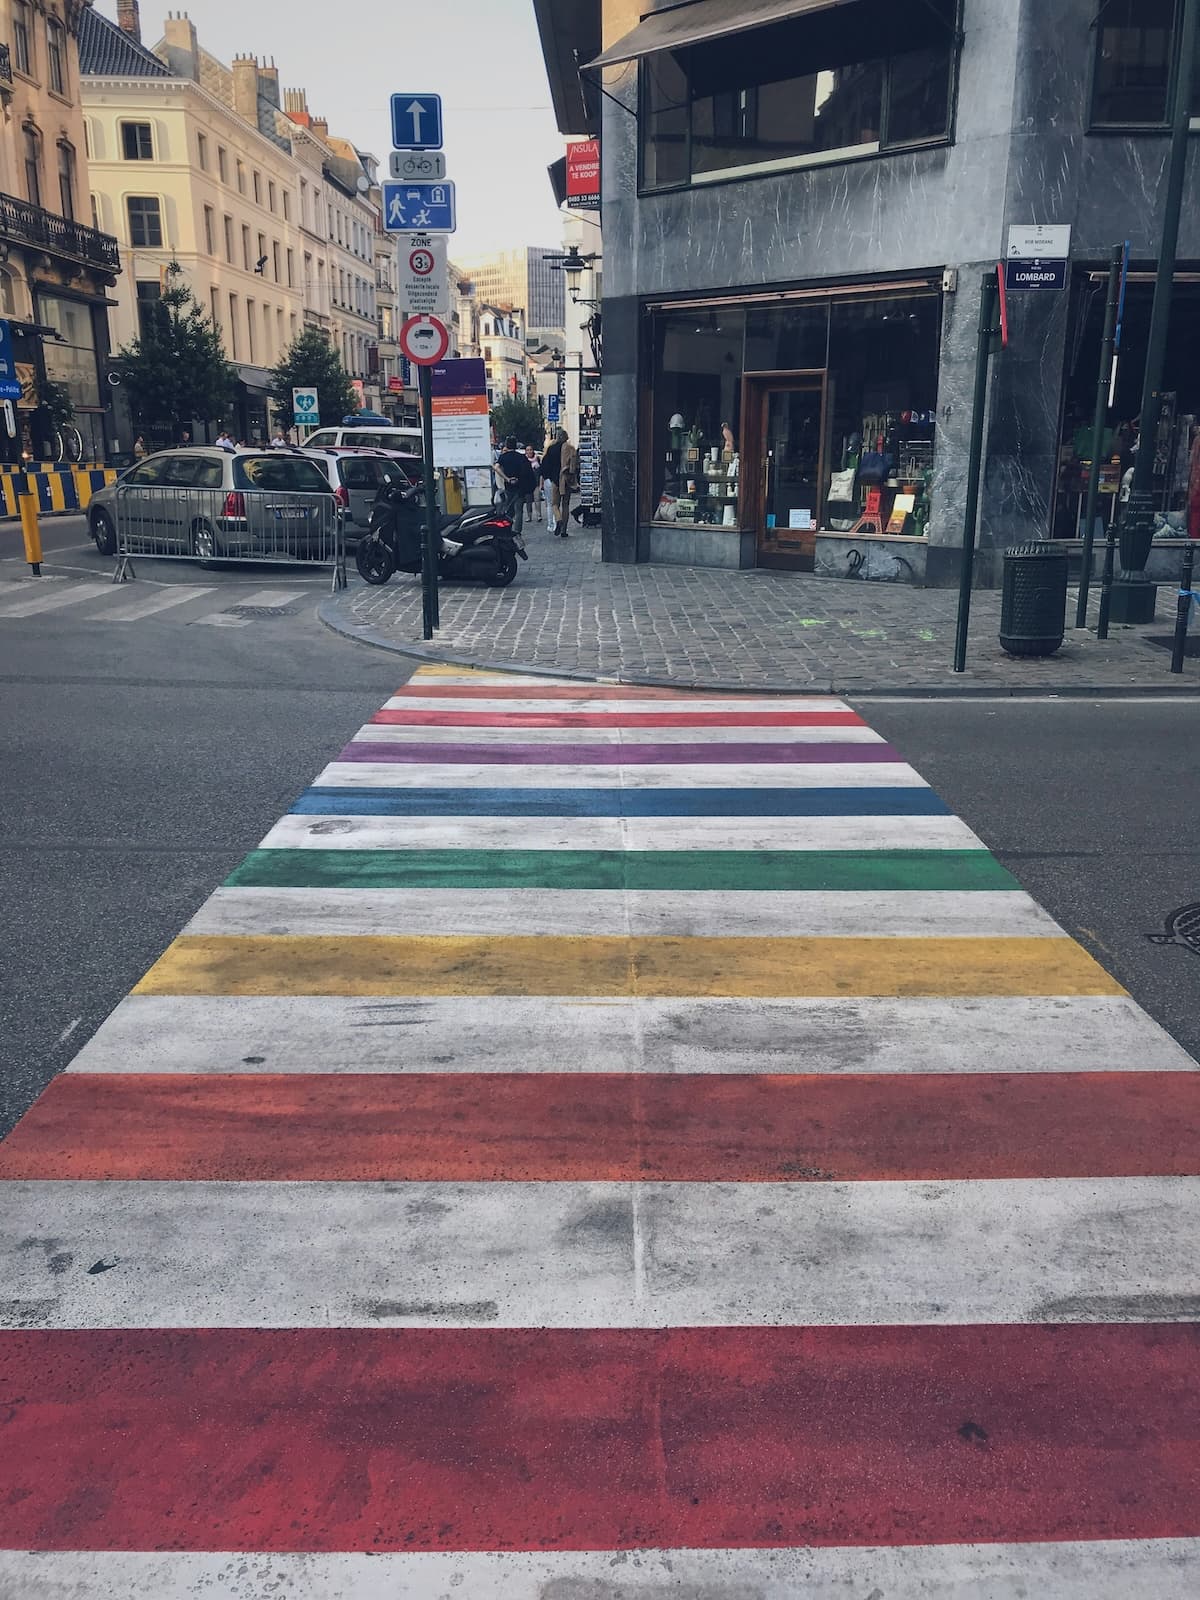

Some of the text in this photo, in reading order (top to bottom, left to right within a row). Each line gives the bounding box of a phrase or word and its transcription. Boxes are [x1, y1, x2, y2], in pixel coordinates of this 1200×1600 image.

[569, 143, 599, 160] INSULA
[575, 163, 600, 171] VENDRE
[580, 170, 597, 178] KOOP
[411, 238, 431, 246] ZONE
[1015, 272, 1056, 281] LOMBARD
